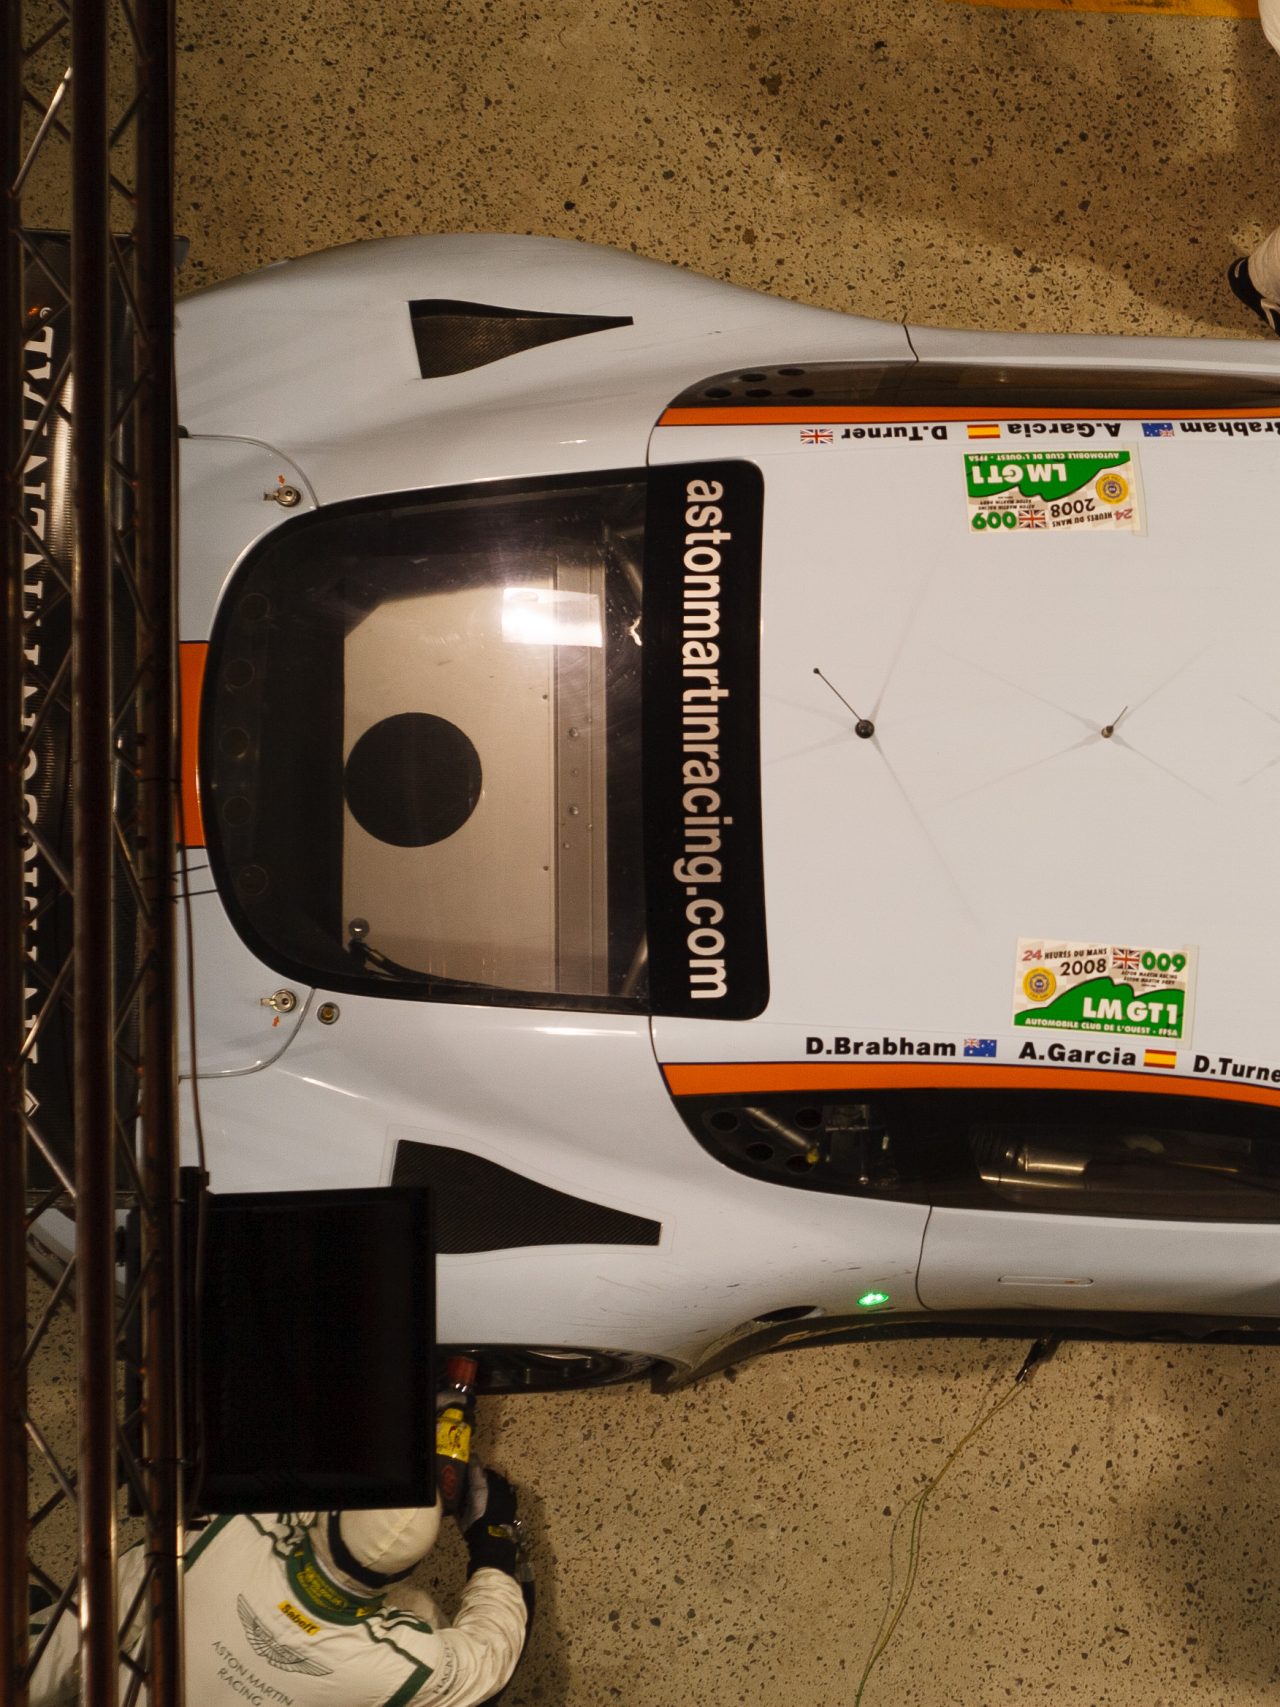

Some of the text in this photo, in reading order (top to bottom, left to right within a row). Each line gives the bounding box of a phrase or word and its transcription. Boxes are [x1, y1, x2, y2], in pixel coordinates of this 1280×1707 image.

[841, 425, 948, 443] D.Turner
[1006, 422, 1121, 439] A.Garcia
[1045, 452, 1065, 460] CLUB
[1050, 498, 1096, 518] 2008
[1051, 508, 1134, 528] 24 HEURES DU MANS
[971, 511, 1017, 530] 009
[672, 479, 733, 1000] astonmartinracing.com
[1022, 948, 1107, 961] 24 HEURES DU MANS
[1141, 951, 1186, 973] 009
[1060, 958, 1107, 977] 2008
[1025, 1018, 1079, 1029] AUTOMOBILE
[1081, 1021, 1101, 1031] CLUB
[1104, 1022, 1114, 1032] DE
[1117, 1024, 1151, 1034] L'OUEST
[805, 1036, 957, 1058] D.Brabham
[1018, 1040, 1137, 1067] A.Garcia
[282, 1603, 316, 1635] Sabelt
[212, 1640, 294, 1707] ASTON MARTIN
[217, 1667, 263, 1707] RACING
